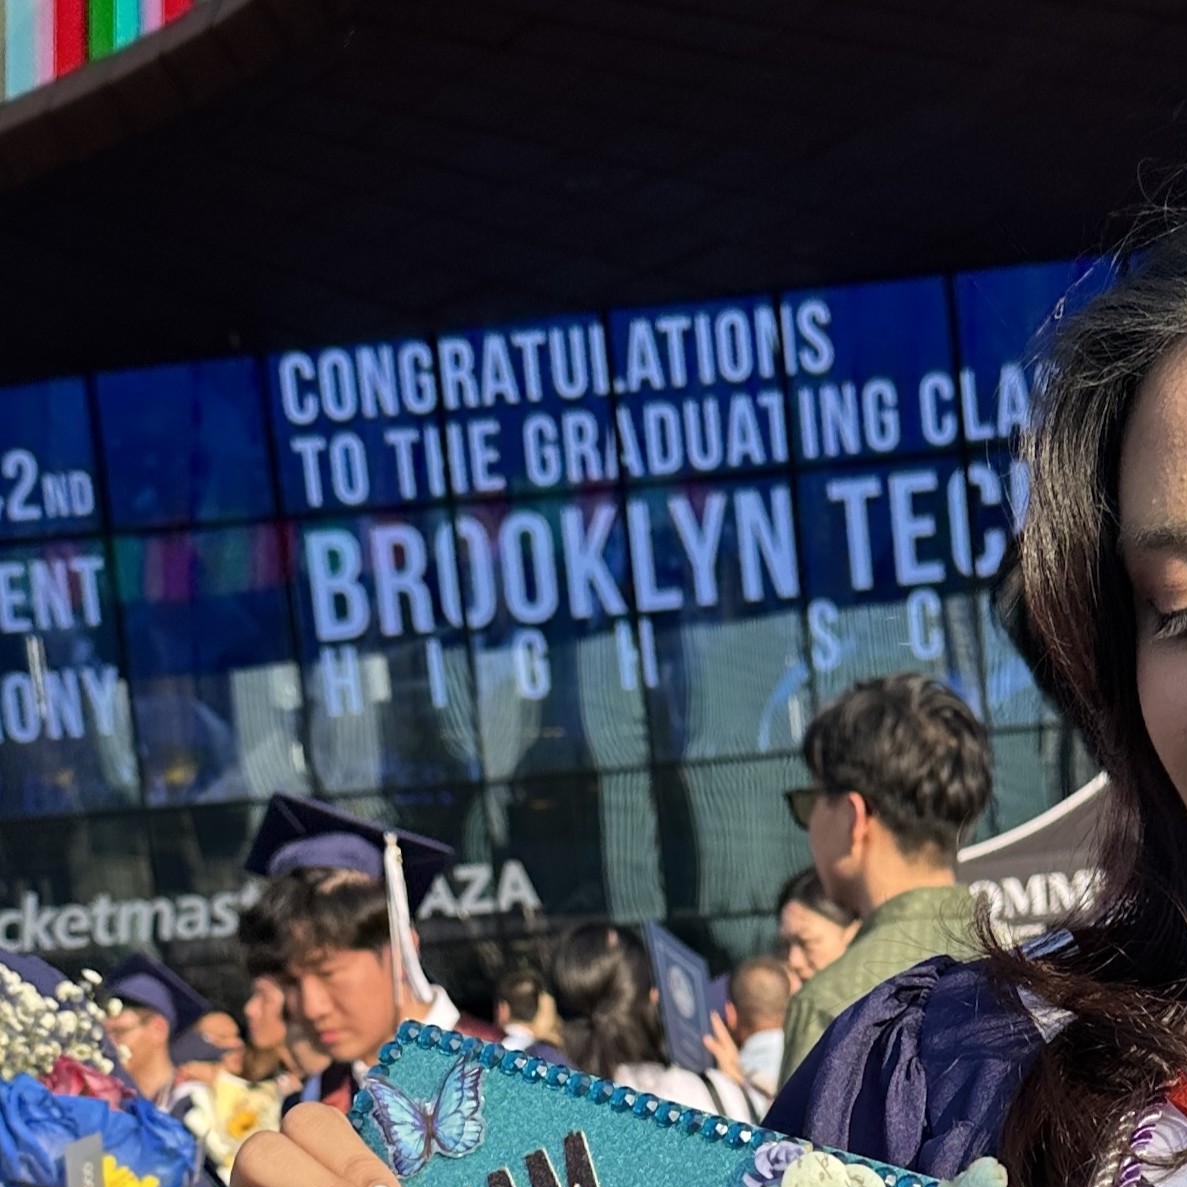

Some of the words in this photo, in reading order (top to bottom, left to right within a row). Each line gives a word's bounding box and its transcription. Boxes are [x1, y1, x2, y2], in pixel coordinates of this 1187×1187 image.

[278, 300, 834, 426] CONGRATULATIONS
[290, 434, 371, 509] TO
[385, 417, 507, 503] THE
[521, 378, 900, 490] GRADUATING
[918, 360, 1045, 446] CLA
[0, 448, 95, 522] 2ND
[0, 556, 104, 632] ENT
[303, 483, 799, 643] BROOKLYN
[0, 664, 119, 744] ONY
[0, 874, 264, 950] cketmas
